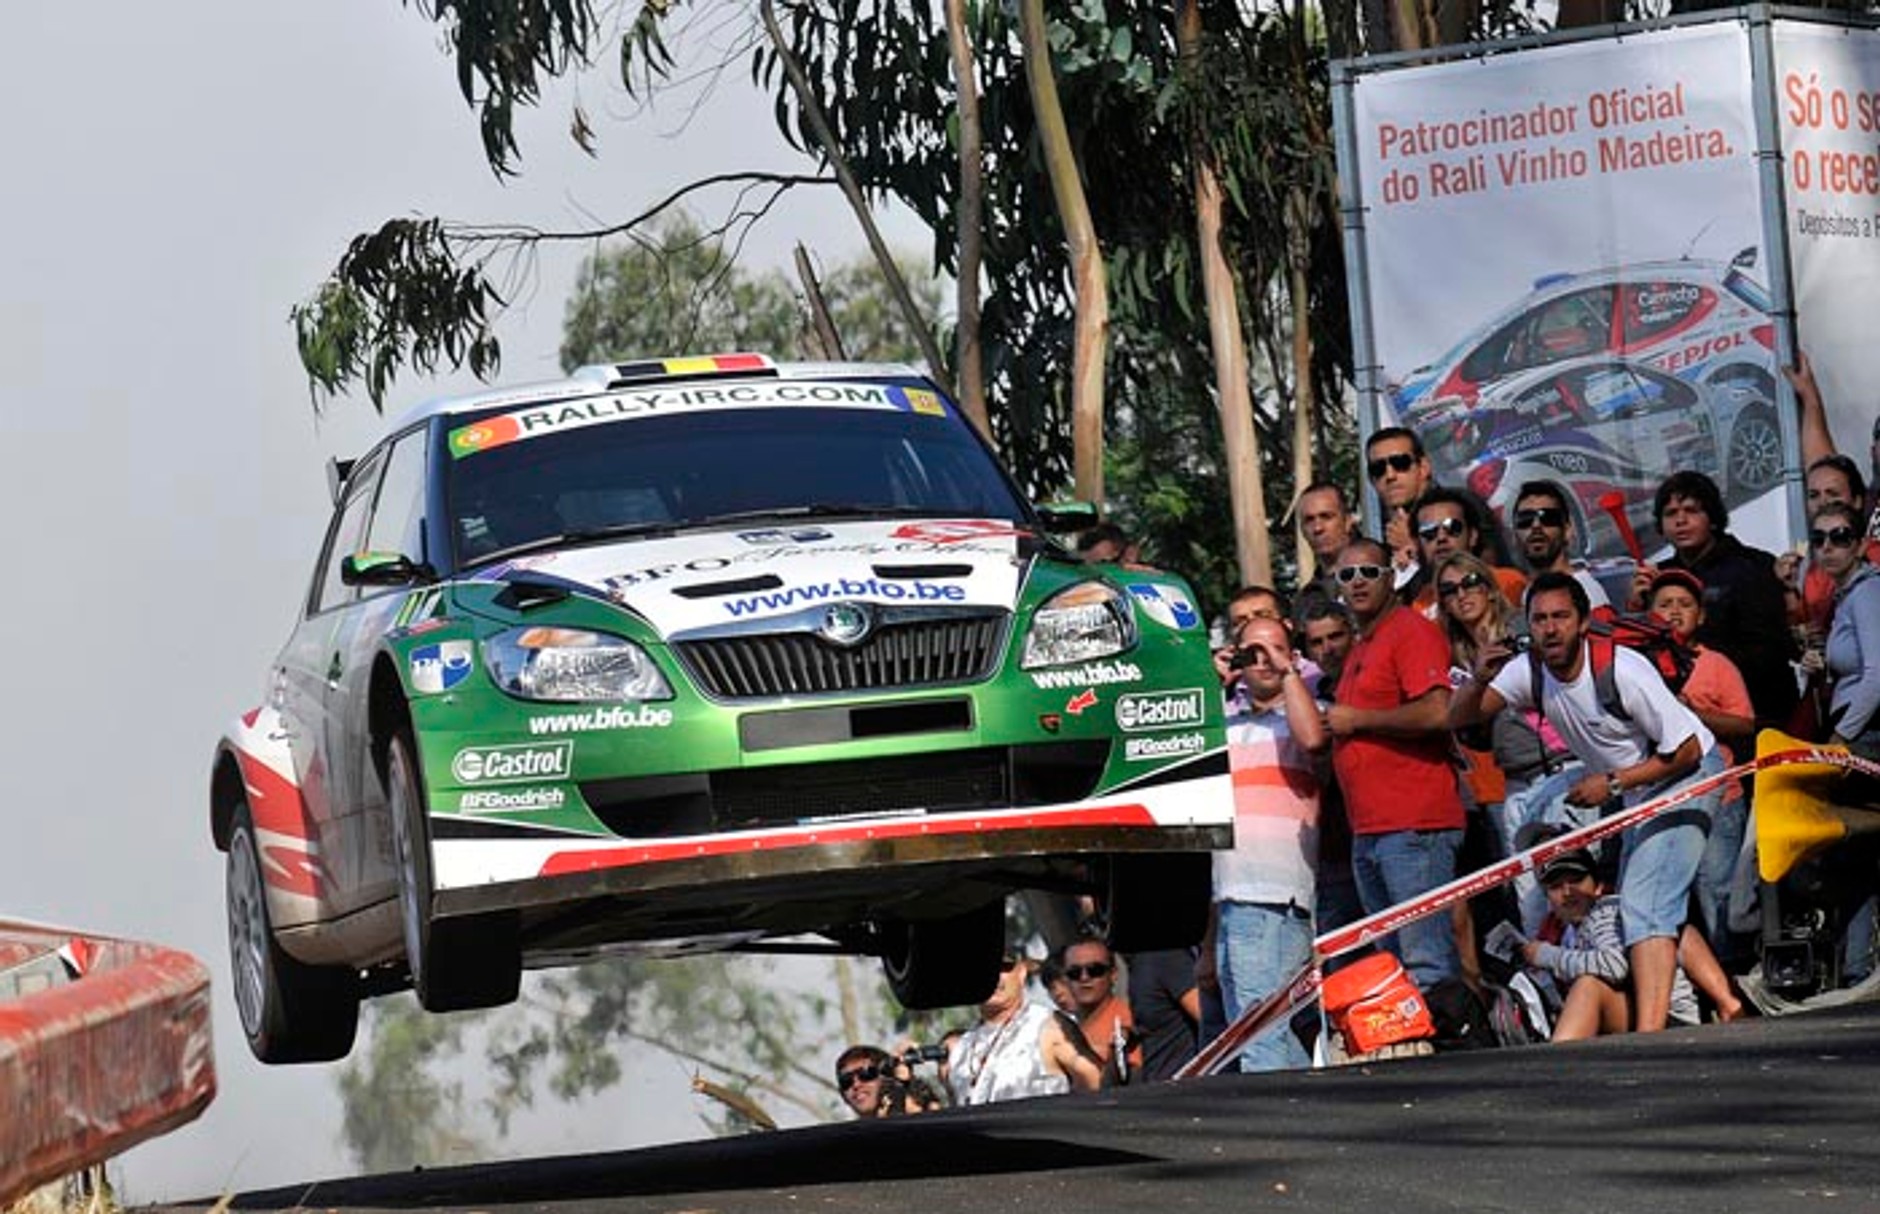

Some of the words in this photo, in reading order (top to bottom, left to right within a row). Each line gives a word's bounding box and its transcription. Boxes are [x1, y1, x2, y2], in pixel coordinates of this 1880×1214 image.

[1378, 102, 1579, 160] Patrocinador
[1588, 82, 1685, 129] Oficial
[1785, 73, 1823, 128] Só
[1831, 88, 1849, 130] o
[1382, 168, 1420, 204] do
[1430, 154, 1487, 197] Rali
[1495, 147, 1588, 187] Vinho
[1598, 125, 1735, 173] Madeira.
[1793, 149, 1811, 191] o
[1819, 150, 1880, 195] rece
[521, 384, 886, 433] RALLY-IRC.COM
[723, 577, 966, 617] www.bfo.be
[1032, 661, 1142, 688] www.bfo.be
[529, 706, 673, 734] www.bfo.be
[1138, 695, 1199, 724] Castrol
[485, 747, 563, 778] Castrol
[461, 788, 564, 811] BFGoodrich
